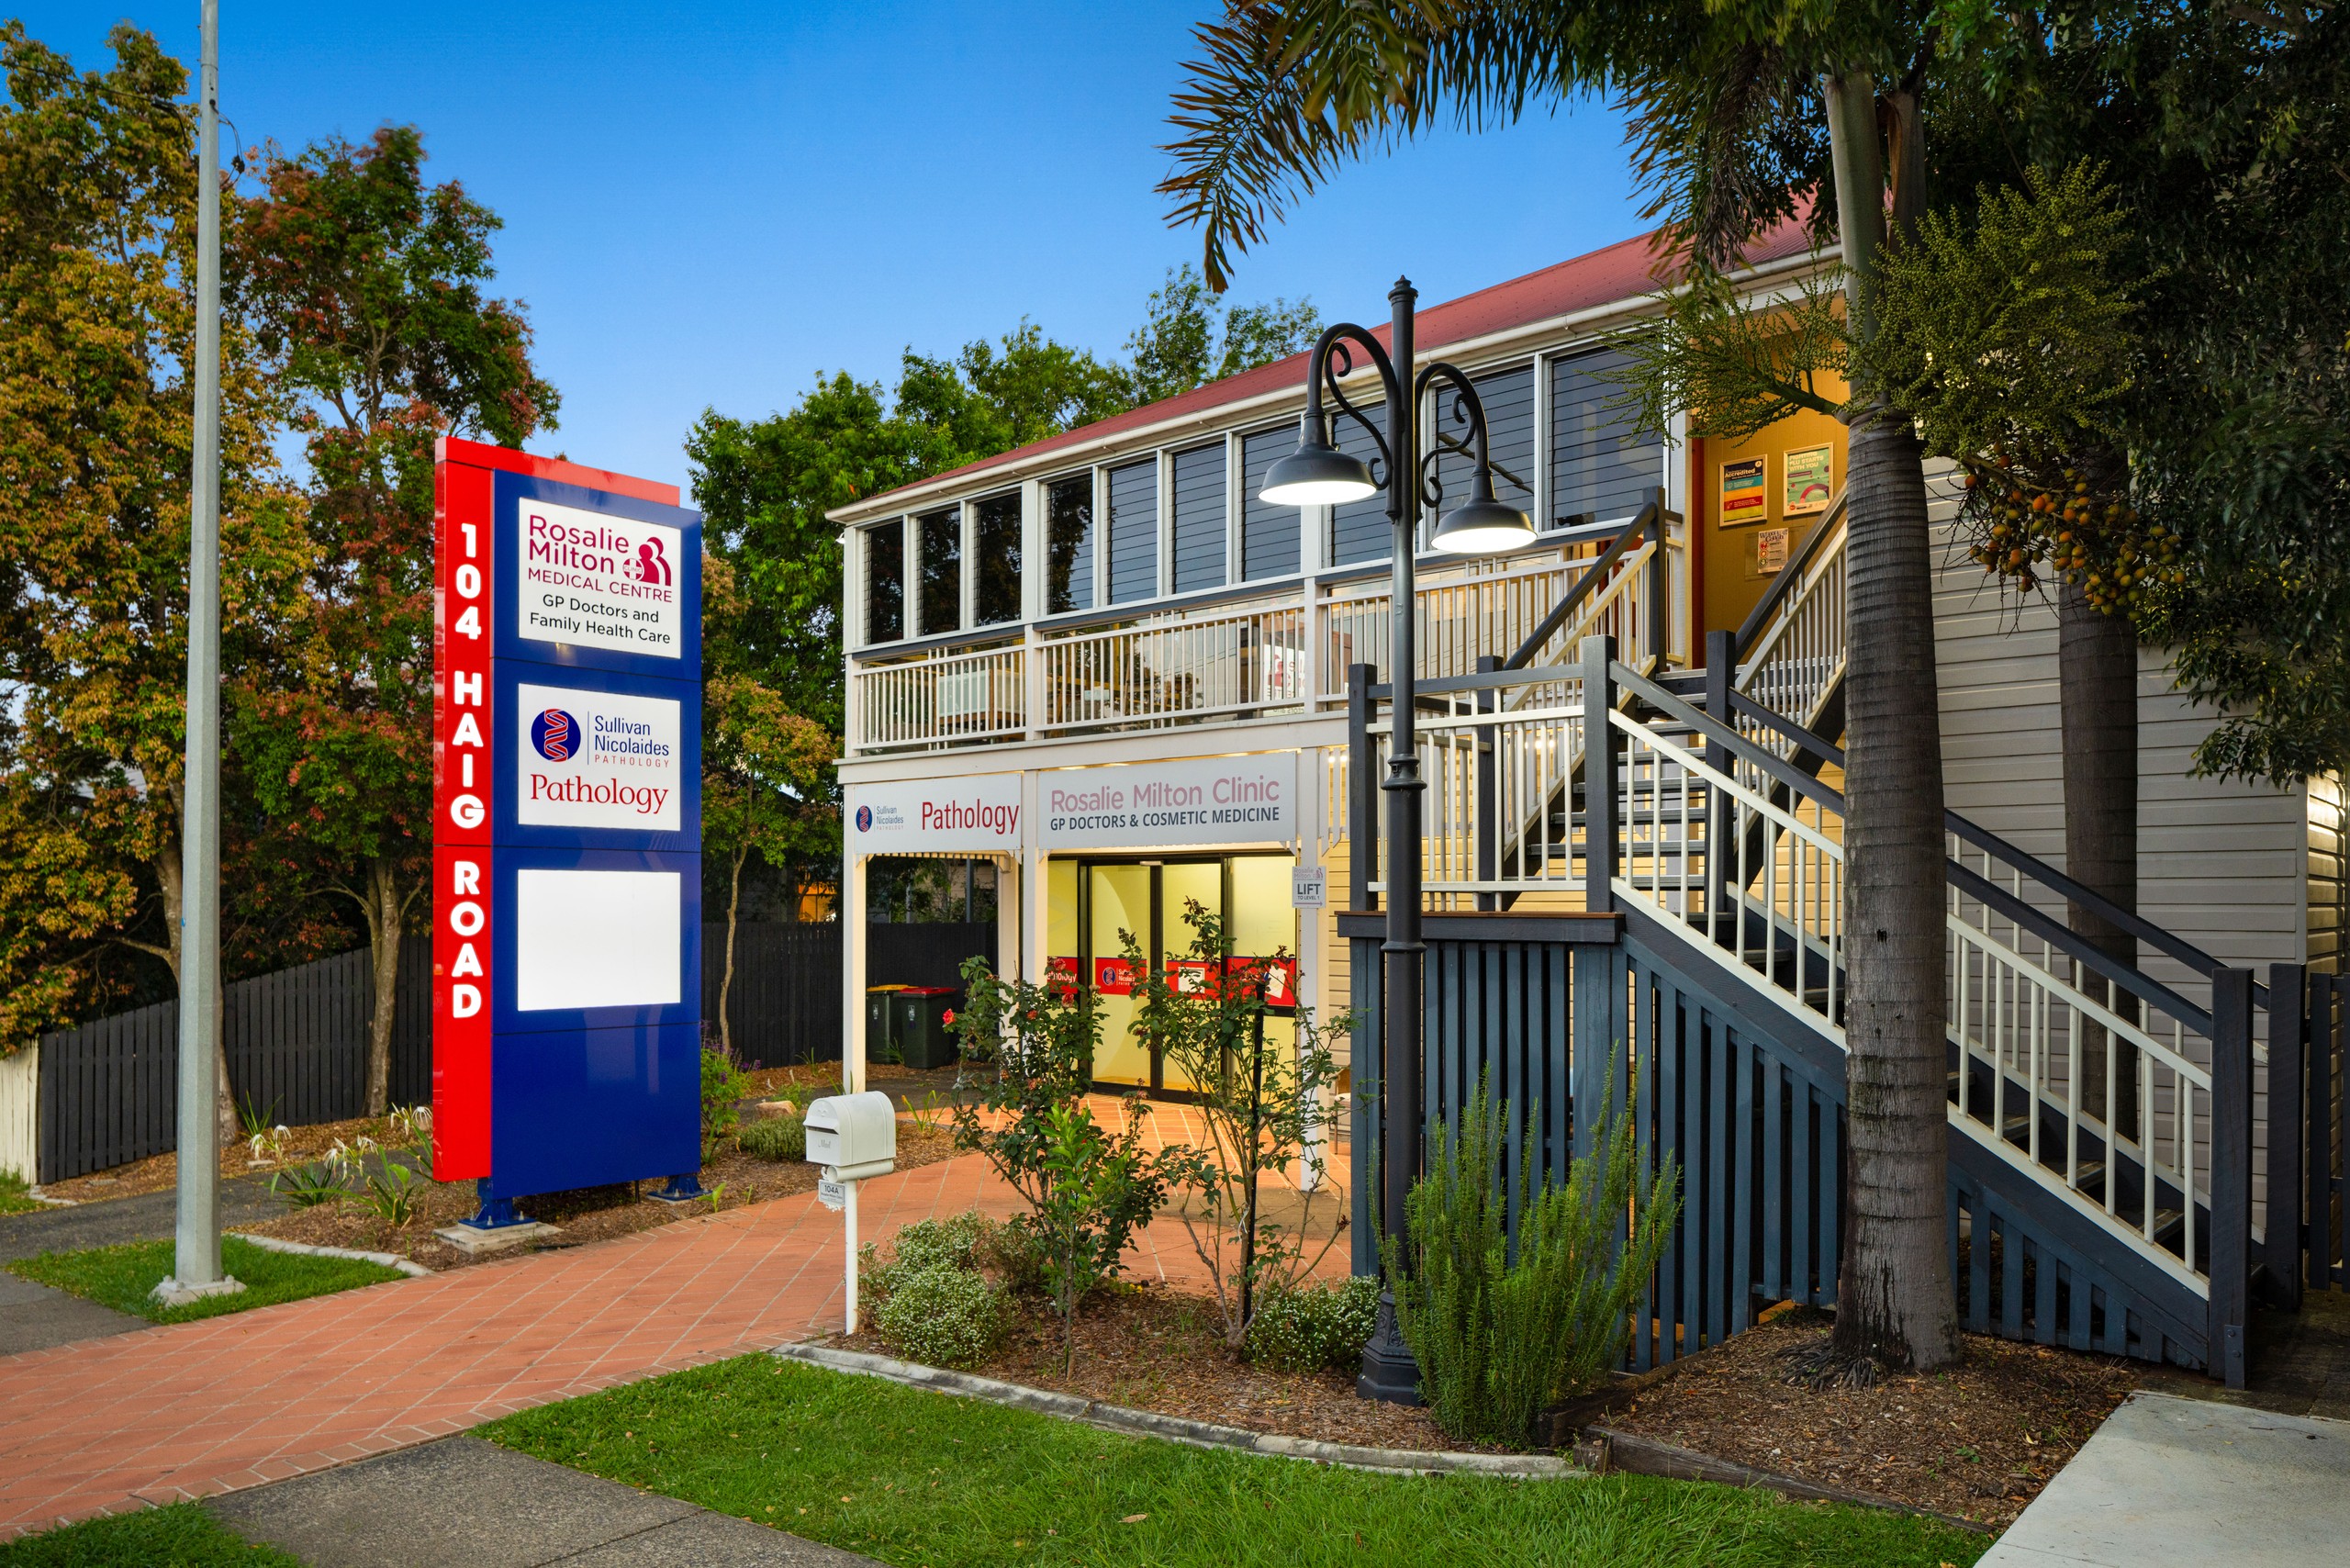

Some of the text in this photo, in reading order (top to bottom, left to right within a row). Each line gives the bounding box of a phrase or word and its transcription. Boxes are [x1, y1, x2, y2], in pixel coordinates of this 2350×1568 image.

[1725, 467, 1756, 477] Accredited
[529, 514, 630, 554] Rosalie
[529, 538, 614, 575] Milton
[623, 566, 642, 574] CLINIC
[528, 567, 673, 603] MEDICAL CENTRE
[543, 594, 659, 623] GP Doctors and
[530, 611, 671, 644] Family Health Care
[594, 715, 651, 735] Sullivan
[594, 734, 669, 756] Nicolaides
[450, 522, 486, 1019] 104 HAIG ROAD
[594, 754, 669, 768] PATHOLOGY
[530, 773, 669, 814] Pathology
[1051, 775, 1280, 812] Rosalie Milton Clinic
[876, 805, 898, 815] Sullivan
[876, 815, 904, 824] Nicolaides
[922, 799, 1020, 834] Pathology
[1050, 807, 1280, 831] GP DOCTORS & COSMETIC MEDICINE
[1297, 883, 1321, 895] LIFT
[824, 1184, 839, 1194] 104A
